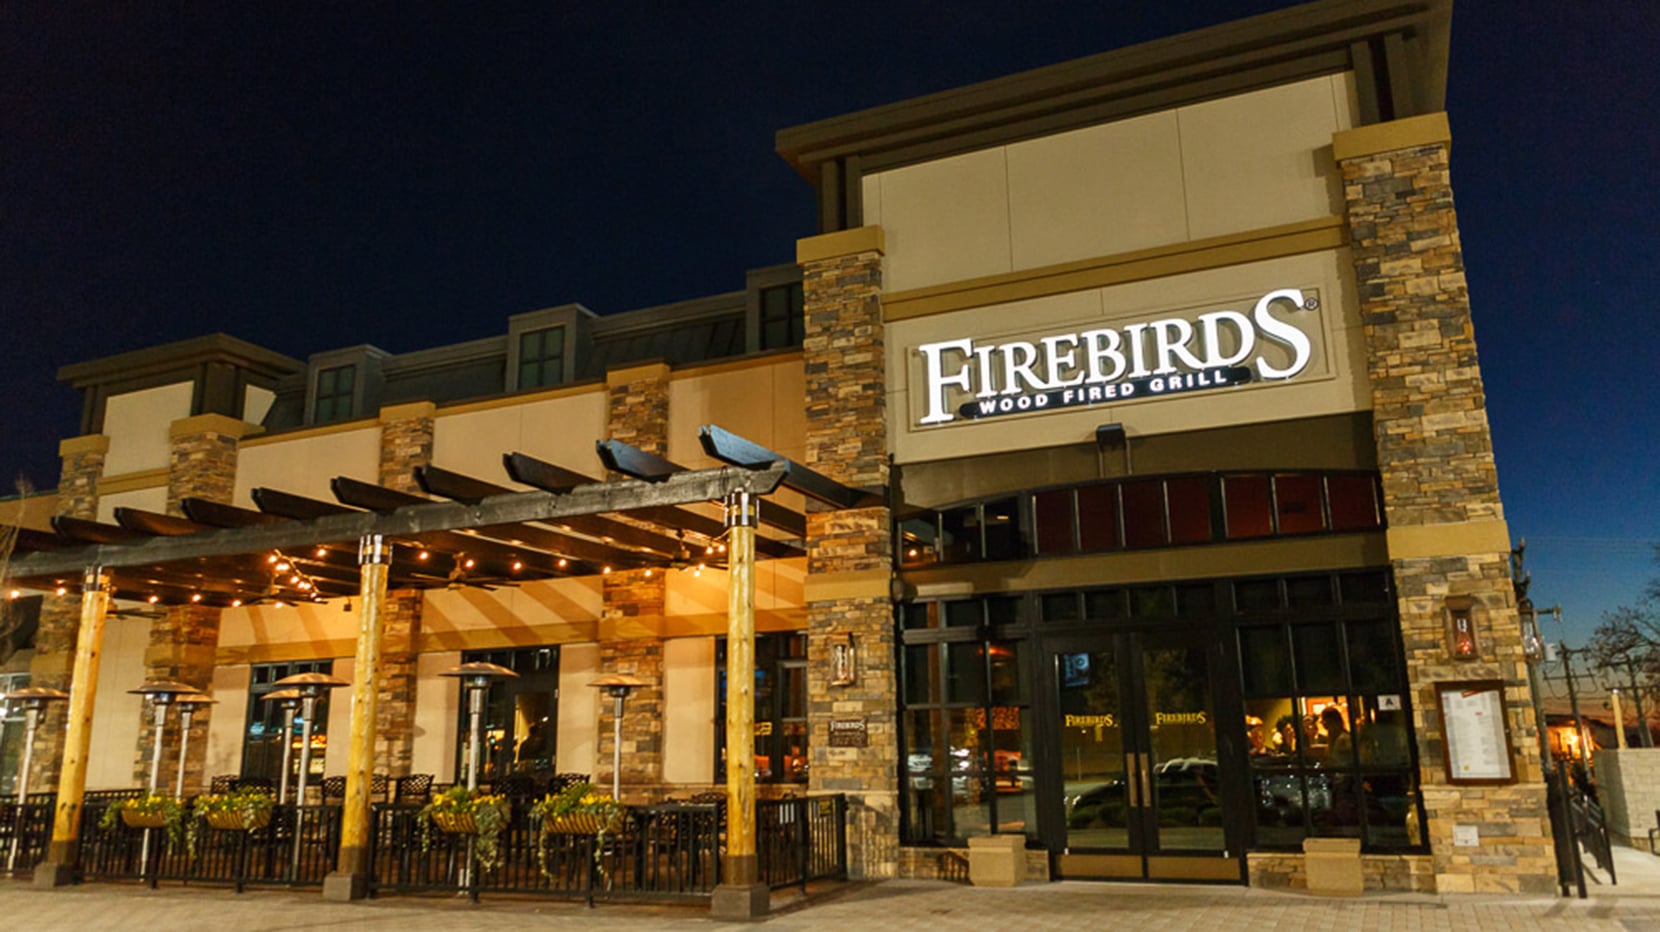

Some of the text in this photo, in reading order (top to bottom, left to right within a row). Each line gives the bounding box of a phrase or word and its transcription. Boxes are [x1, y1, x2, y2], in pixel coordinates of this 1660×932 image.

[919, 288, 1311, 424] FIREBIRDS
[979, 370, 1228, 415] WOOD FIRED GRILL
[1065, 714, 1113, 727] FIREBIRDS
[1155, 711, 1206, 724] FIREBIRDS
